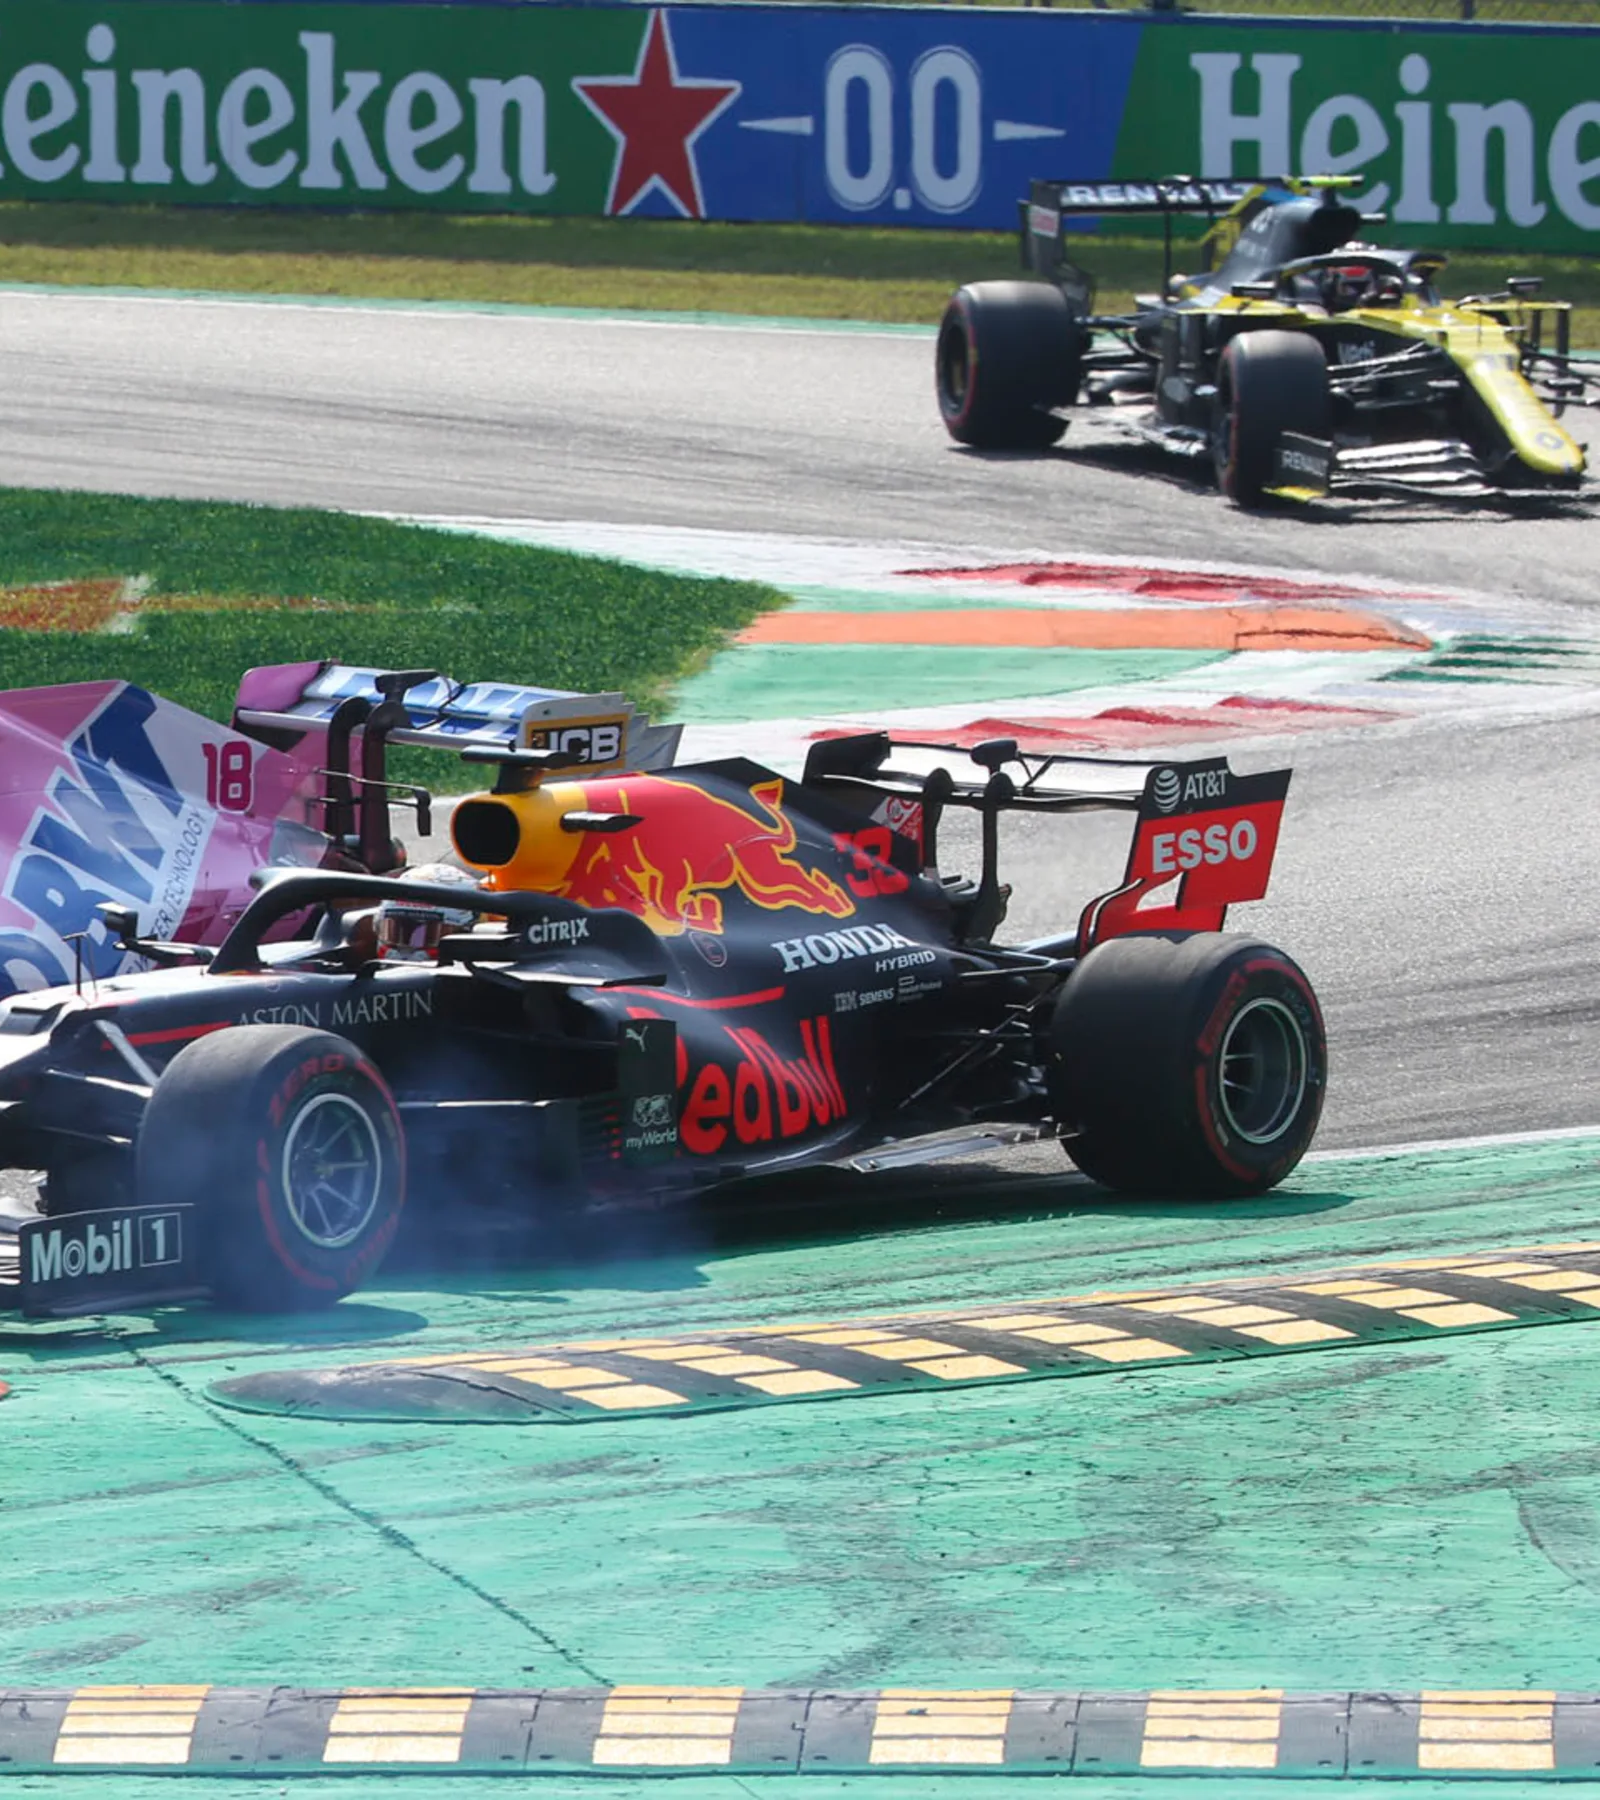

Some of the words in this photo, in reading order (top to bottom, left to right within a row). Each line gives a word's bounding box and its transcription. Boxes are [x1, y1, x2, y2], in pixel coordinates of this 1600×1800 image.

[824, 44, 982, 213] 0.0
[201, 741, 252, 812] 18
[1183, 769, 1228, 801] AT&T
[162, 810, 208, 911] TECHNOLOGY
[1152, 819, 1257, 874] ESSO
[771, 923, 921, 973] HONDA
[875, 949, 937, 973] HYBRID
[239, 1002, 320, 1027] ASTON
[331, 989, 433, 1027] MARTIN
[626, 1128, 678, 1149] myWorld
[31, 1220, 132, 1284] Mobil
